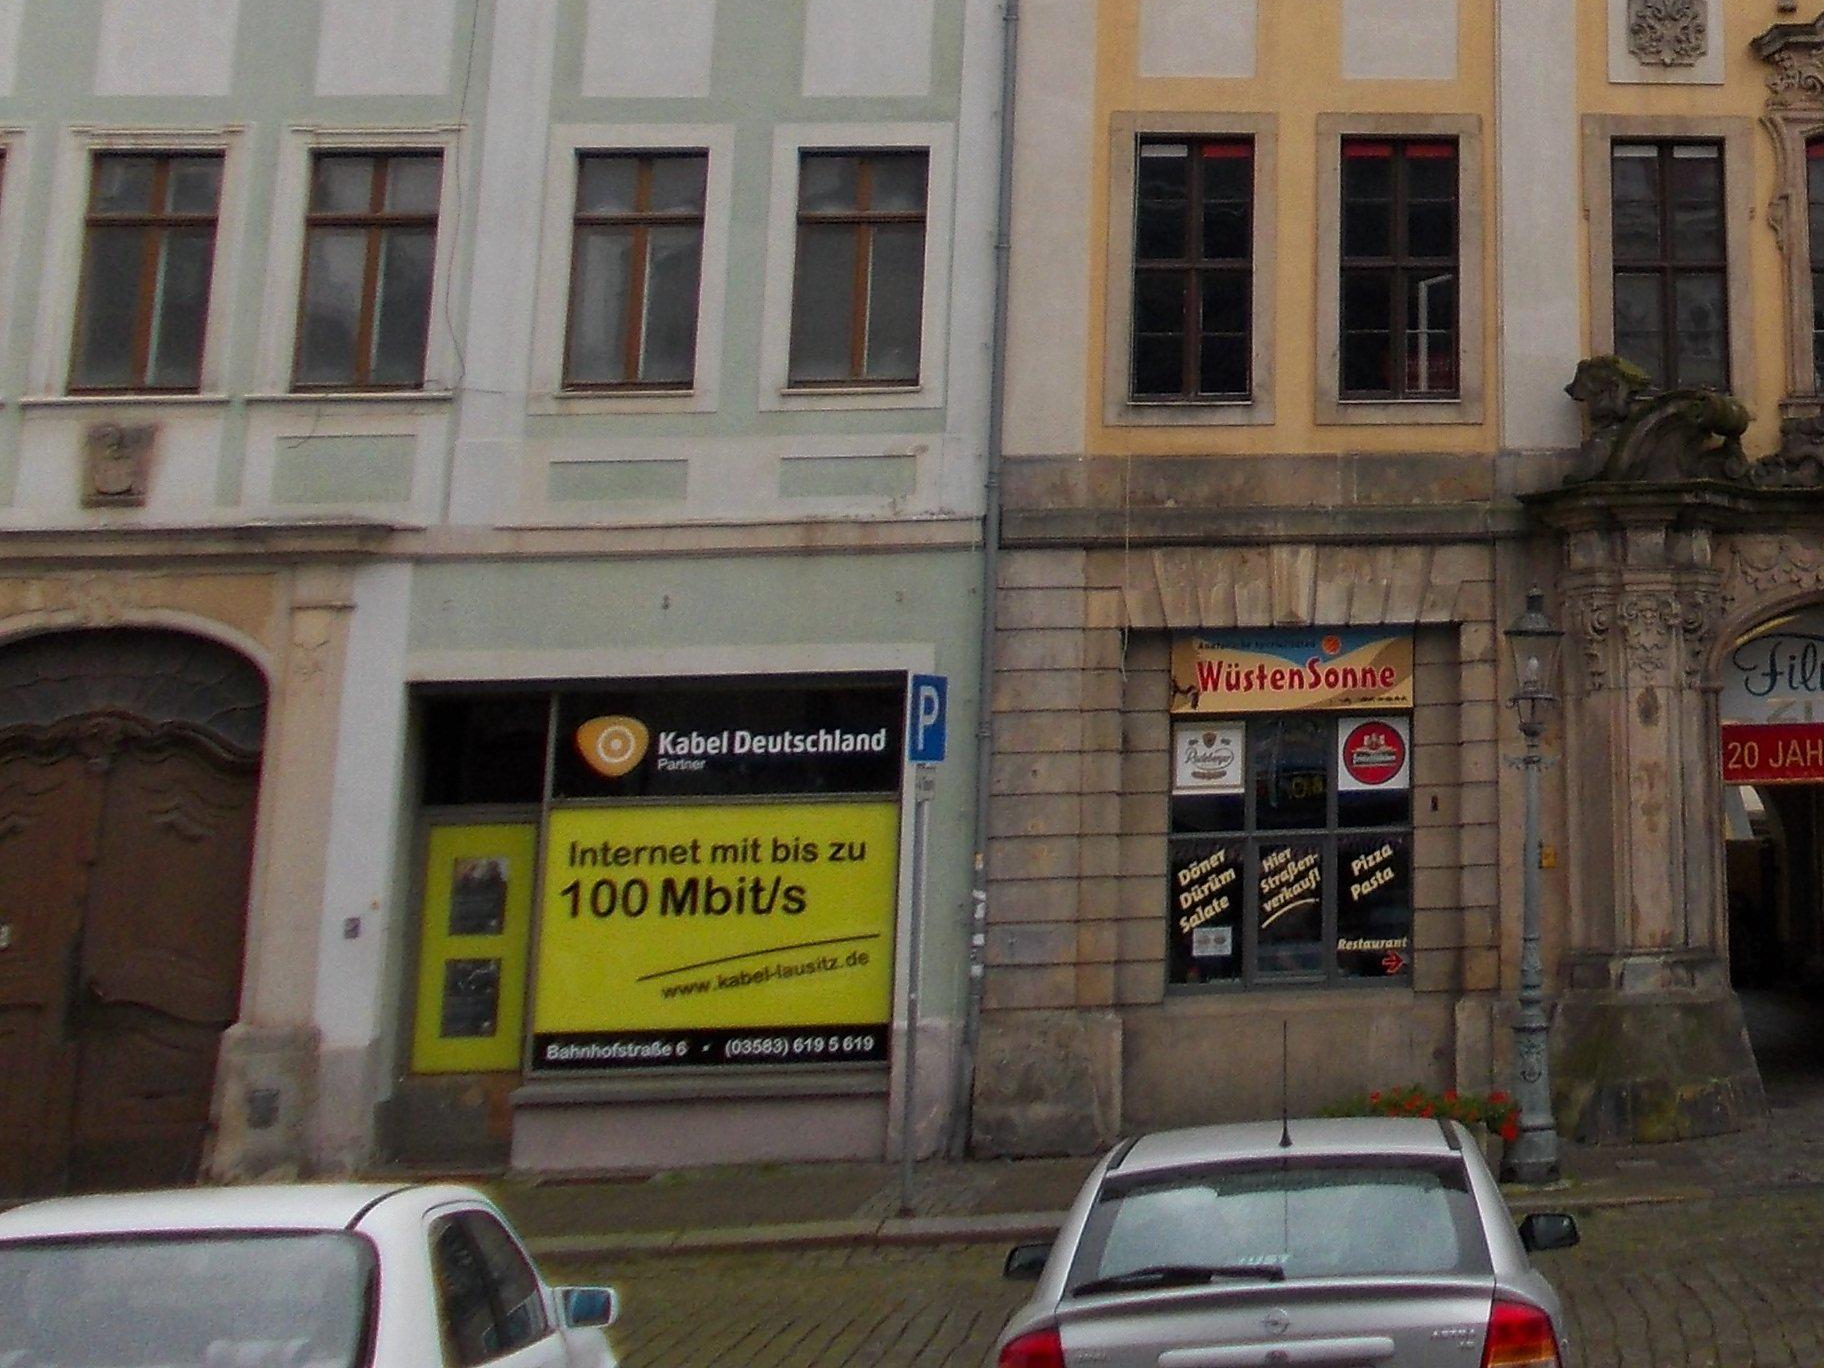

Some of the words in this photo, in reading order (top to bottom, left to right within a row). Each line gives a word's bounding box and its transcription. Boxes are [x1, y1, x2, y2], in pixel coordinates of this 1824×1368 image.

[1196, 656, 1397, 693] WüstenSonne
[918, 685, 939, 751] P
[658, 731, 728, 755] Kabel
[733, 728, 887, 754] Deutschland
[1727, 741, 1759, 770] 20
[657, 758, 706, 771] Partner
[568, 838, 702, 867] Internet
[711, 837, 760, 864] mit
[770, 835, 819, 863] bis
[828, 841, 867, 862] zu
[1178, 848, 1226, 886] Döner
[1262, 847, 1291, 873] Hier
[1350, 843, 1394, 876] Pizza
[1179, 868, 1237, 910] Dürüm
[1260, 854, 1319, 894] Straßen-
[1350, 866, 1395, 901] Pasta
[560, 878, 649, 919] 100
[659, 876, 807, 916] Mbit/s
[1179, 895, 1230, 934] Salate
[1337, 936, 1408, 951] Restaurant
[661, 950, 871, 1000] www.kabel-lausitz.de
[547, 1040, 671, 1060] Bahnhofstraße
[675, 1043, 688, 1057] 6
[793, 1039, 824, 1053] 619
[827, 1038, 839, 1052] 5
[842, 1036, 874, 1051] 619
